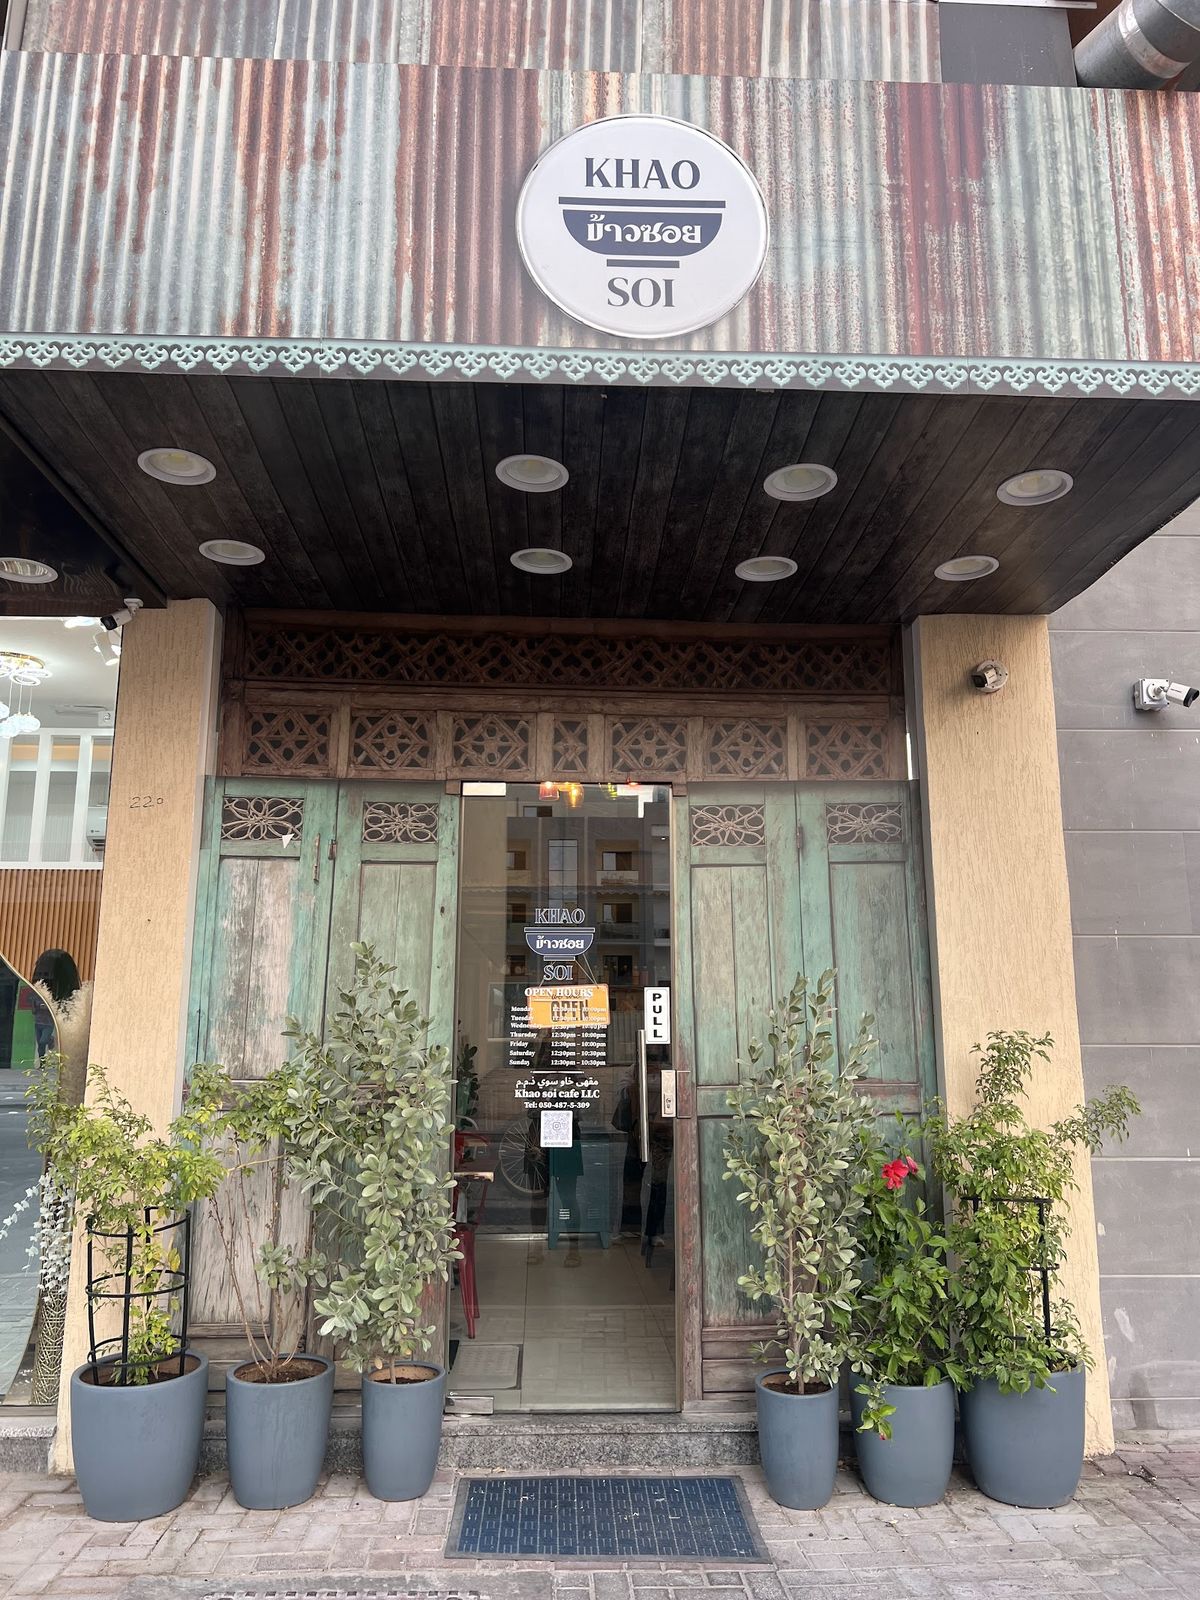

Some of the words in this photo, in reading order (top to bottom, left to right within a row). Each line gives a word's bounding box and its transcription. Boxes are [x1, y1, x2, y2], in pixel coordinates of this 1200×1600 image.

[585, 157, 701, 190] KHAO
[587, 214, 701, 244] ข้าวซอย
[607, 277, 675, 308] SOI
[534, 908, 586, 924] KHAO
[535, 935, 585, 949] ข้าวซอย
[543, 965, 573, 981] SOI
[524, 987, 553, 997] OPEN
[556, 987, 594, 999] HOURS
[652, 993, 663, 1038] PULL
[509, 1031, 538, 1039] Thursday
[509, 1040, 529, 1048] Friday
[509, 1059, 530, 1067] Sunday
[550, 1059, 576, 1067] 12:30pm
[560, 1076, 574, 1087] خاو
[575, 1077, 599, 1087] مقهى
[514, 1089, 540, 1098] Khao
[541, 1089, 557, 1098] soi
[558, 1089, 579, 1098] cafe
[581, 1089, 600, 1098] LLC
[523, 1101, 538, 1109] Tel:
